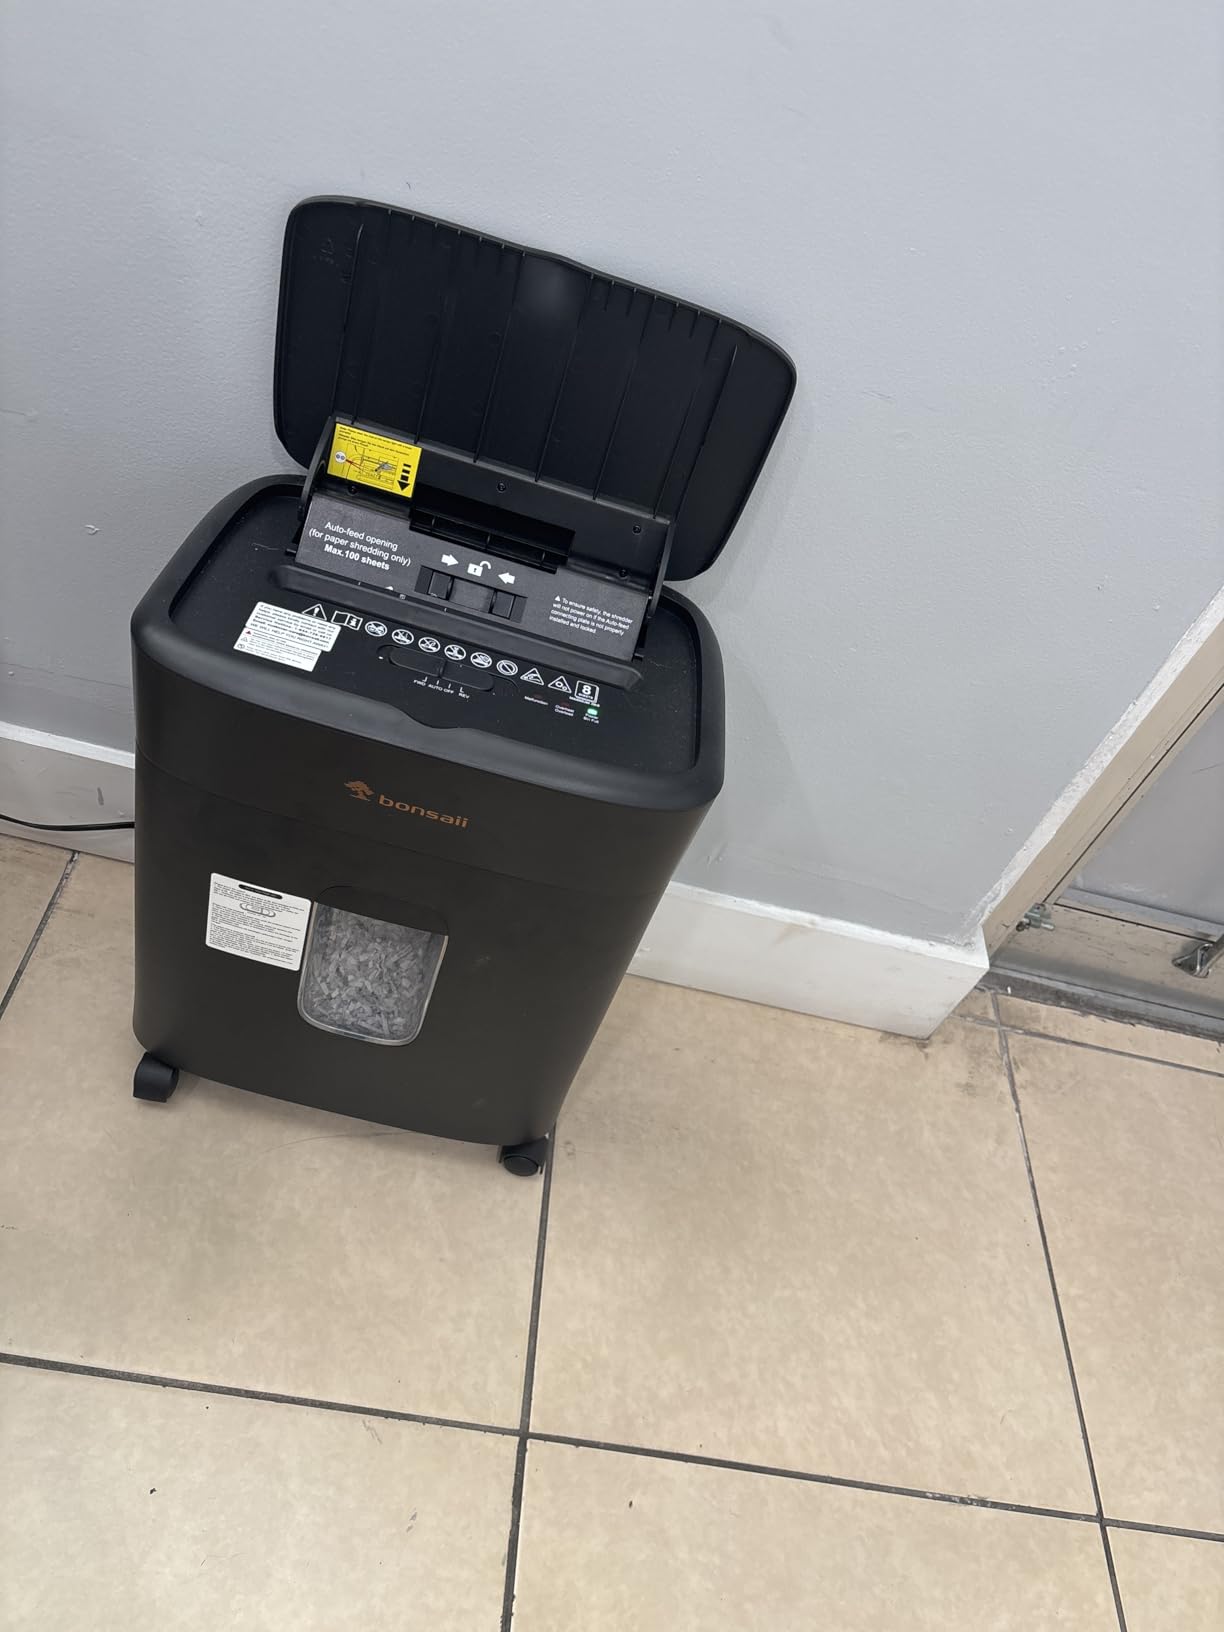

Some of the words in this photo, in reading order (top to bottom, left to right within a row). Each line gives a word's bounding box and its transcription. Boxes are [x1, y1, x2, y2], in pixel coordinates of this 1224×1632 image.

[309, 528, 323, 538] (for
[324, 534, 348, 545] paper
[350, 541, 389, 560] shredding
[391, 554, 411, 567] only)
[325, 522, 364, 539] Auto-feed
[366, 535, 398, 552] opening
[324, 544, 360, 560] Max.100
[361, 557, 390, 570] sheets
[549, 616, 569, 625] installed
[551, 610, 577, 621] connecting
[604, 626, 624, 636] properly
[612, 614, 633, 623] shredder
[582, 685, 591, 695] 8
[379, 795, 468, 828] bonsaii
